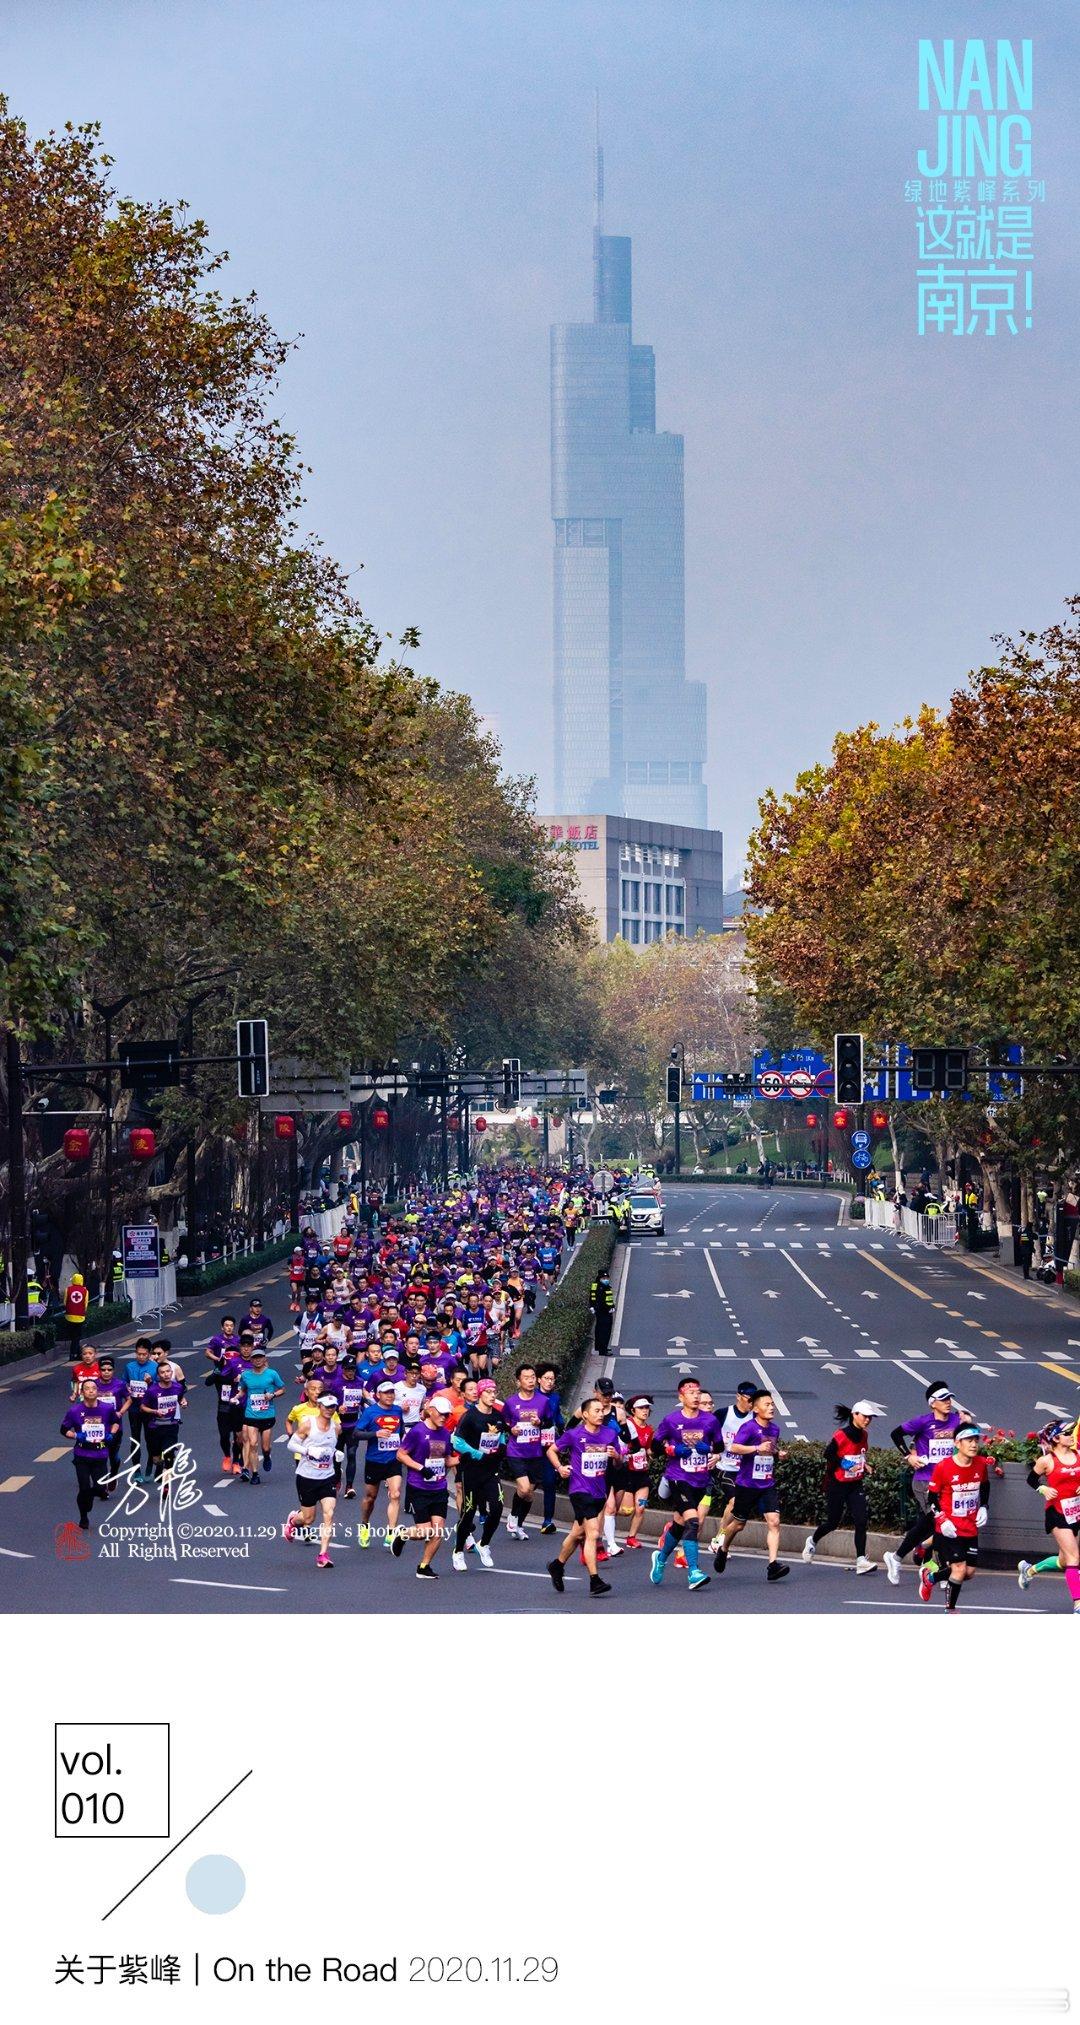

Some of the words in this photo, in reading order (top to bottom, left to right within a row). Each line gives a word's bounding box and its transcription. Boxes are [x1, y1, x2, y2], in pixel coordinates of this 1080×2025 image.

[532, 824, 598, 839] 華飯店
[765, 1078, 780, 1092] 50
